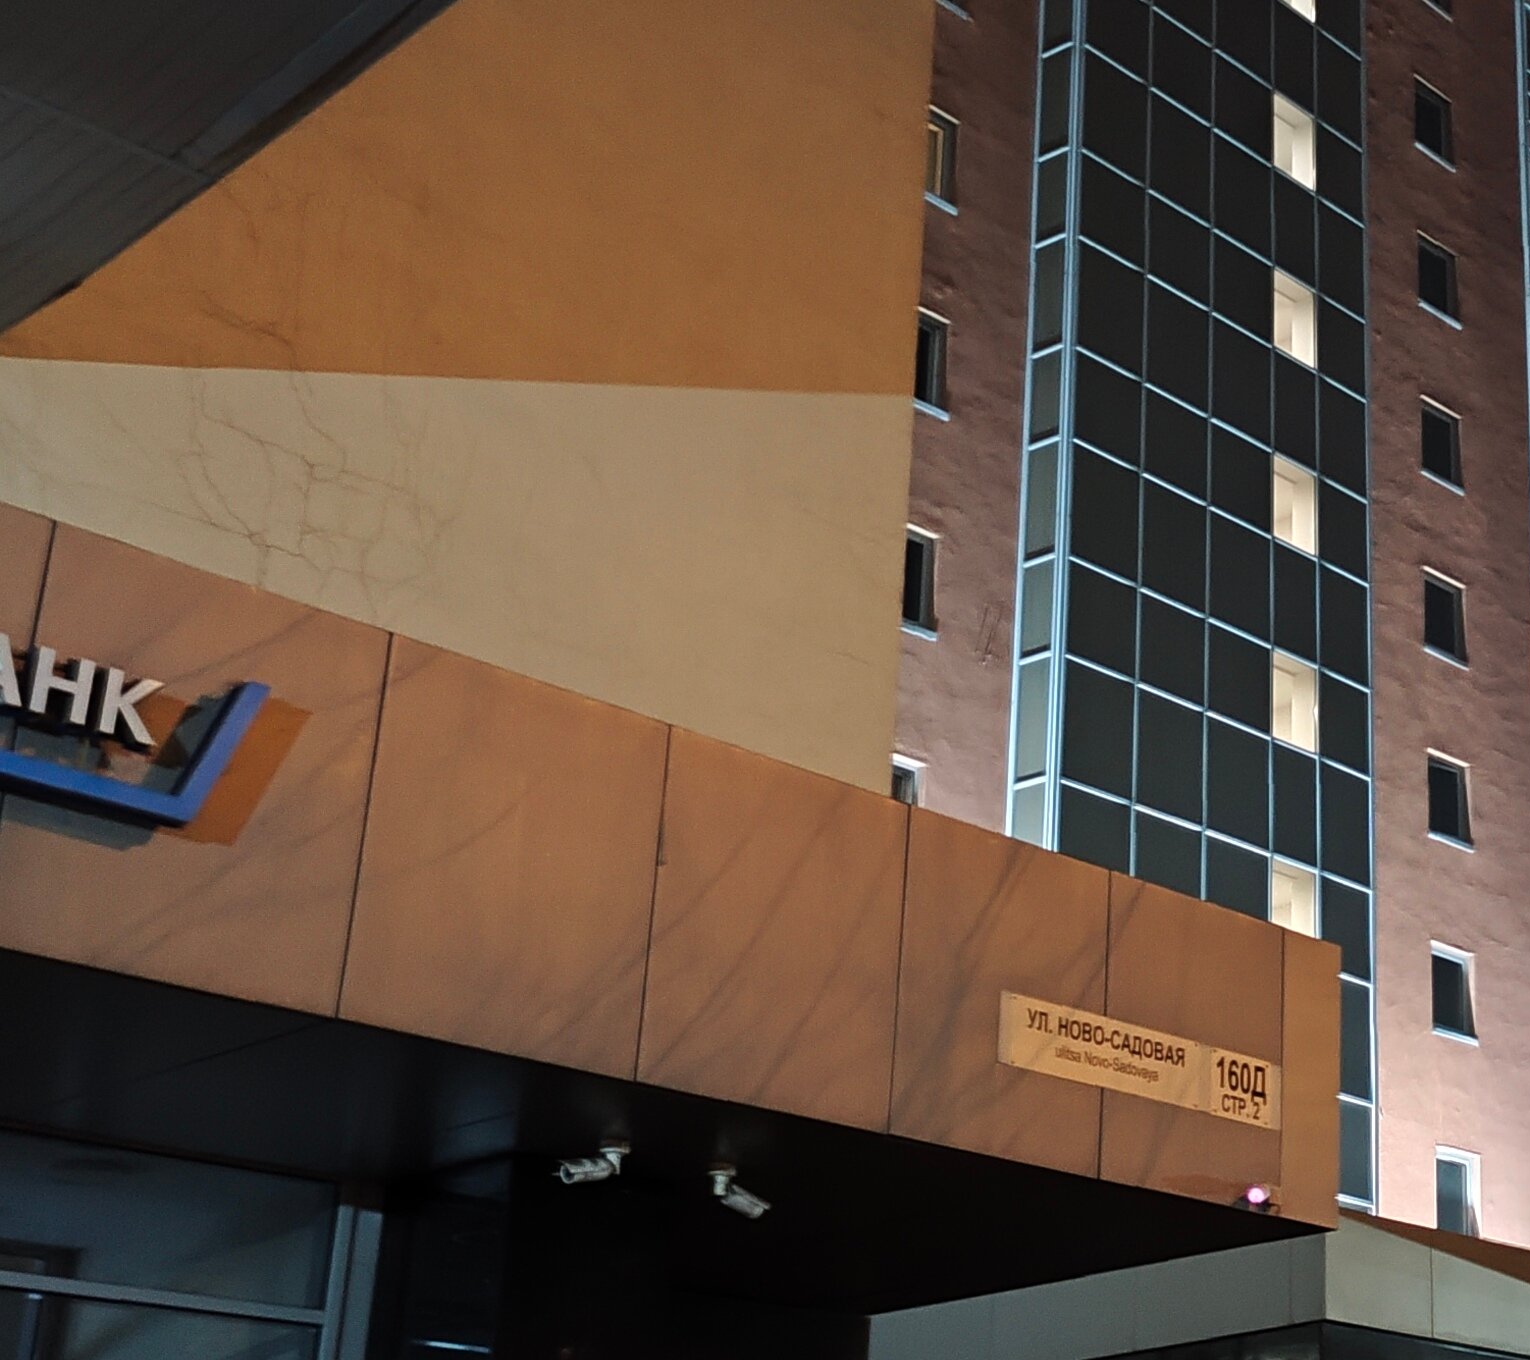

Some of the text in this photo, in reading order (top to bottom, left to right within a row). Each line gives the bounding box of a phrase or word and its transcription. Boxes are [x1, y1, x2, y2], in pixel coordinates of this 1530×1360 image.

[1027, 1007, 1186, 1068] УЛ. НОВО-САДОВАЯ
[1054, 1044, 1160, 1084] ulitsa Novo-Sadovaya
[1216, 1056, 1268, 1107] 160Д
[1252, 1101, 1262, 1121] 2
